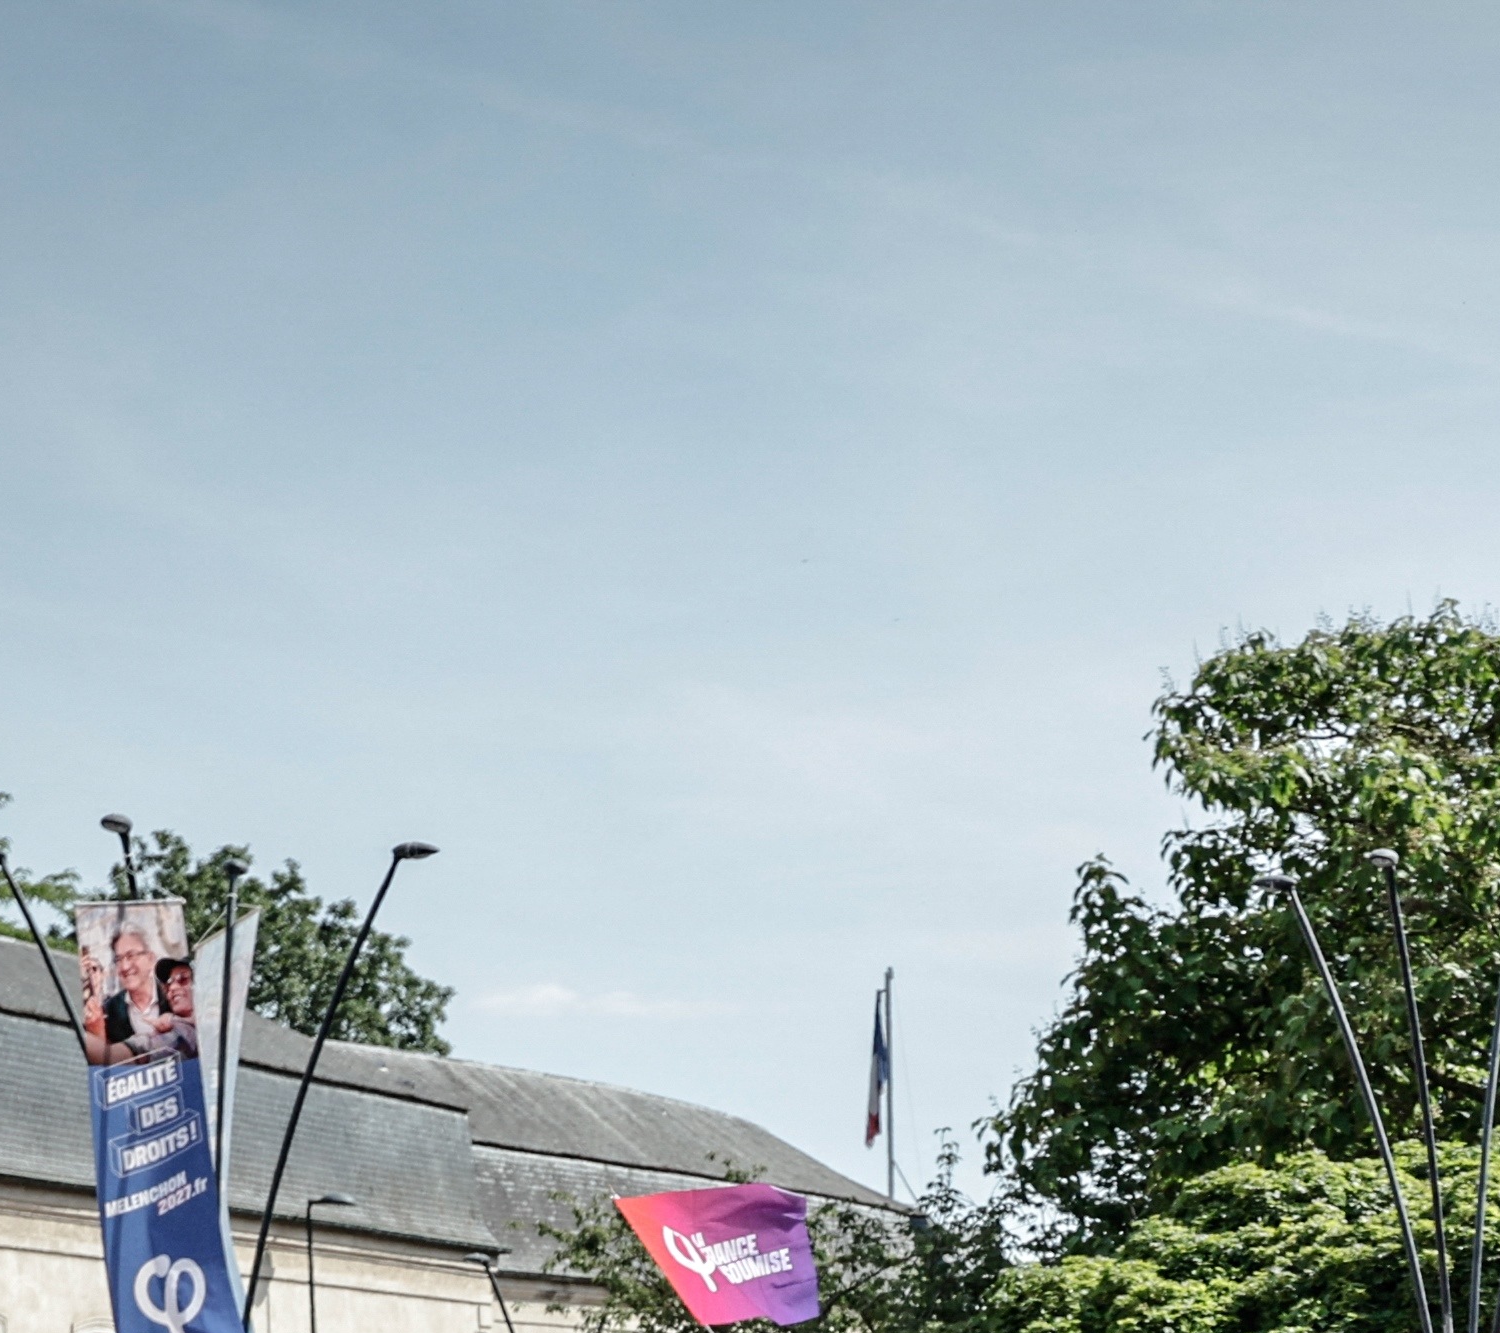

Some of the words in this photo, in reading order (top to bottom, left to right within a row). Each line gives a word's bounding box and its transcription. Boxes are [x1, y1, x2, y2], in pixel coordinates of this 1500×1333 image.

[106, 1055, 177, 1103] ÉGALITÉ
[140, 1097, 179, 1129] DES
[122, 1120, 197, 1171] DROITS!
[105, 1170, 187, 1218] MELENCHON
[157, 1176, 208, 1216] 2027.fr
[718, 1247, 793, 1284] OUMISE
